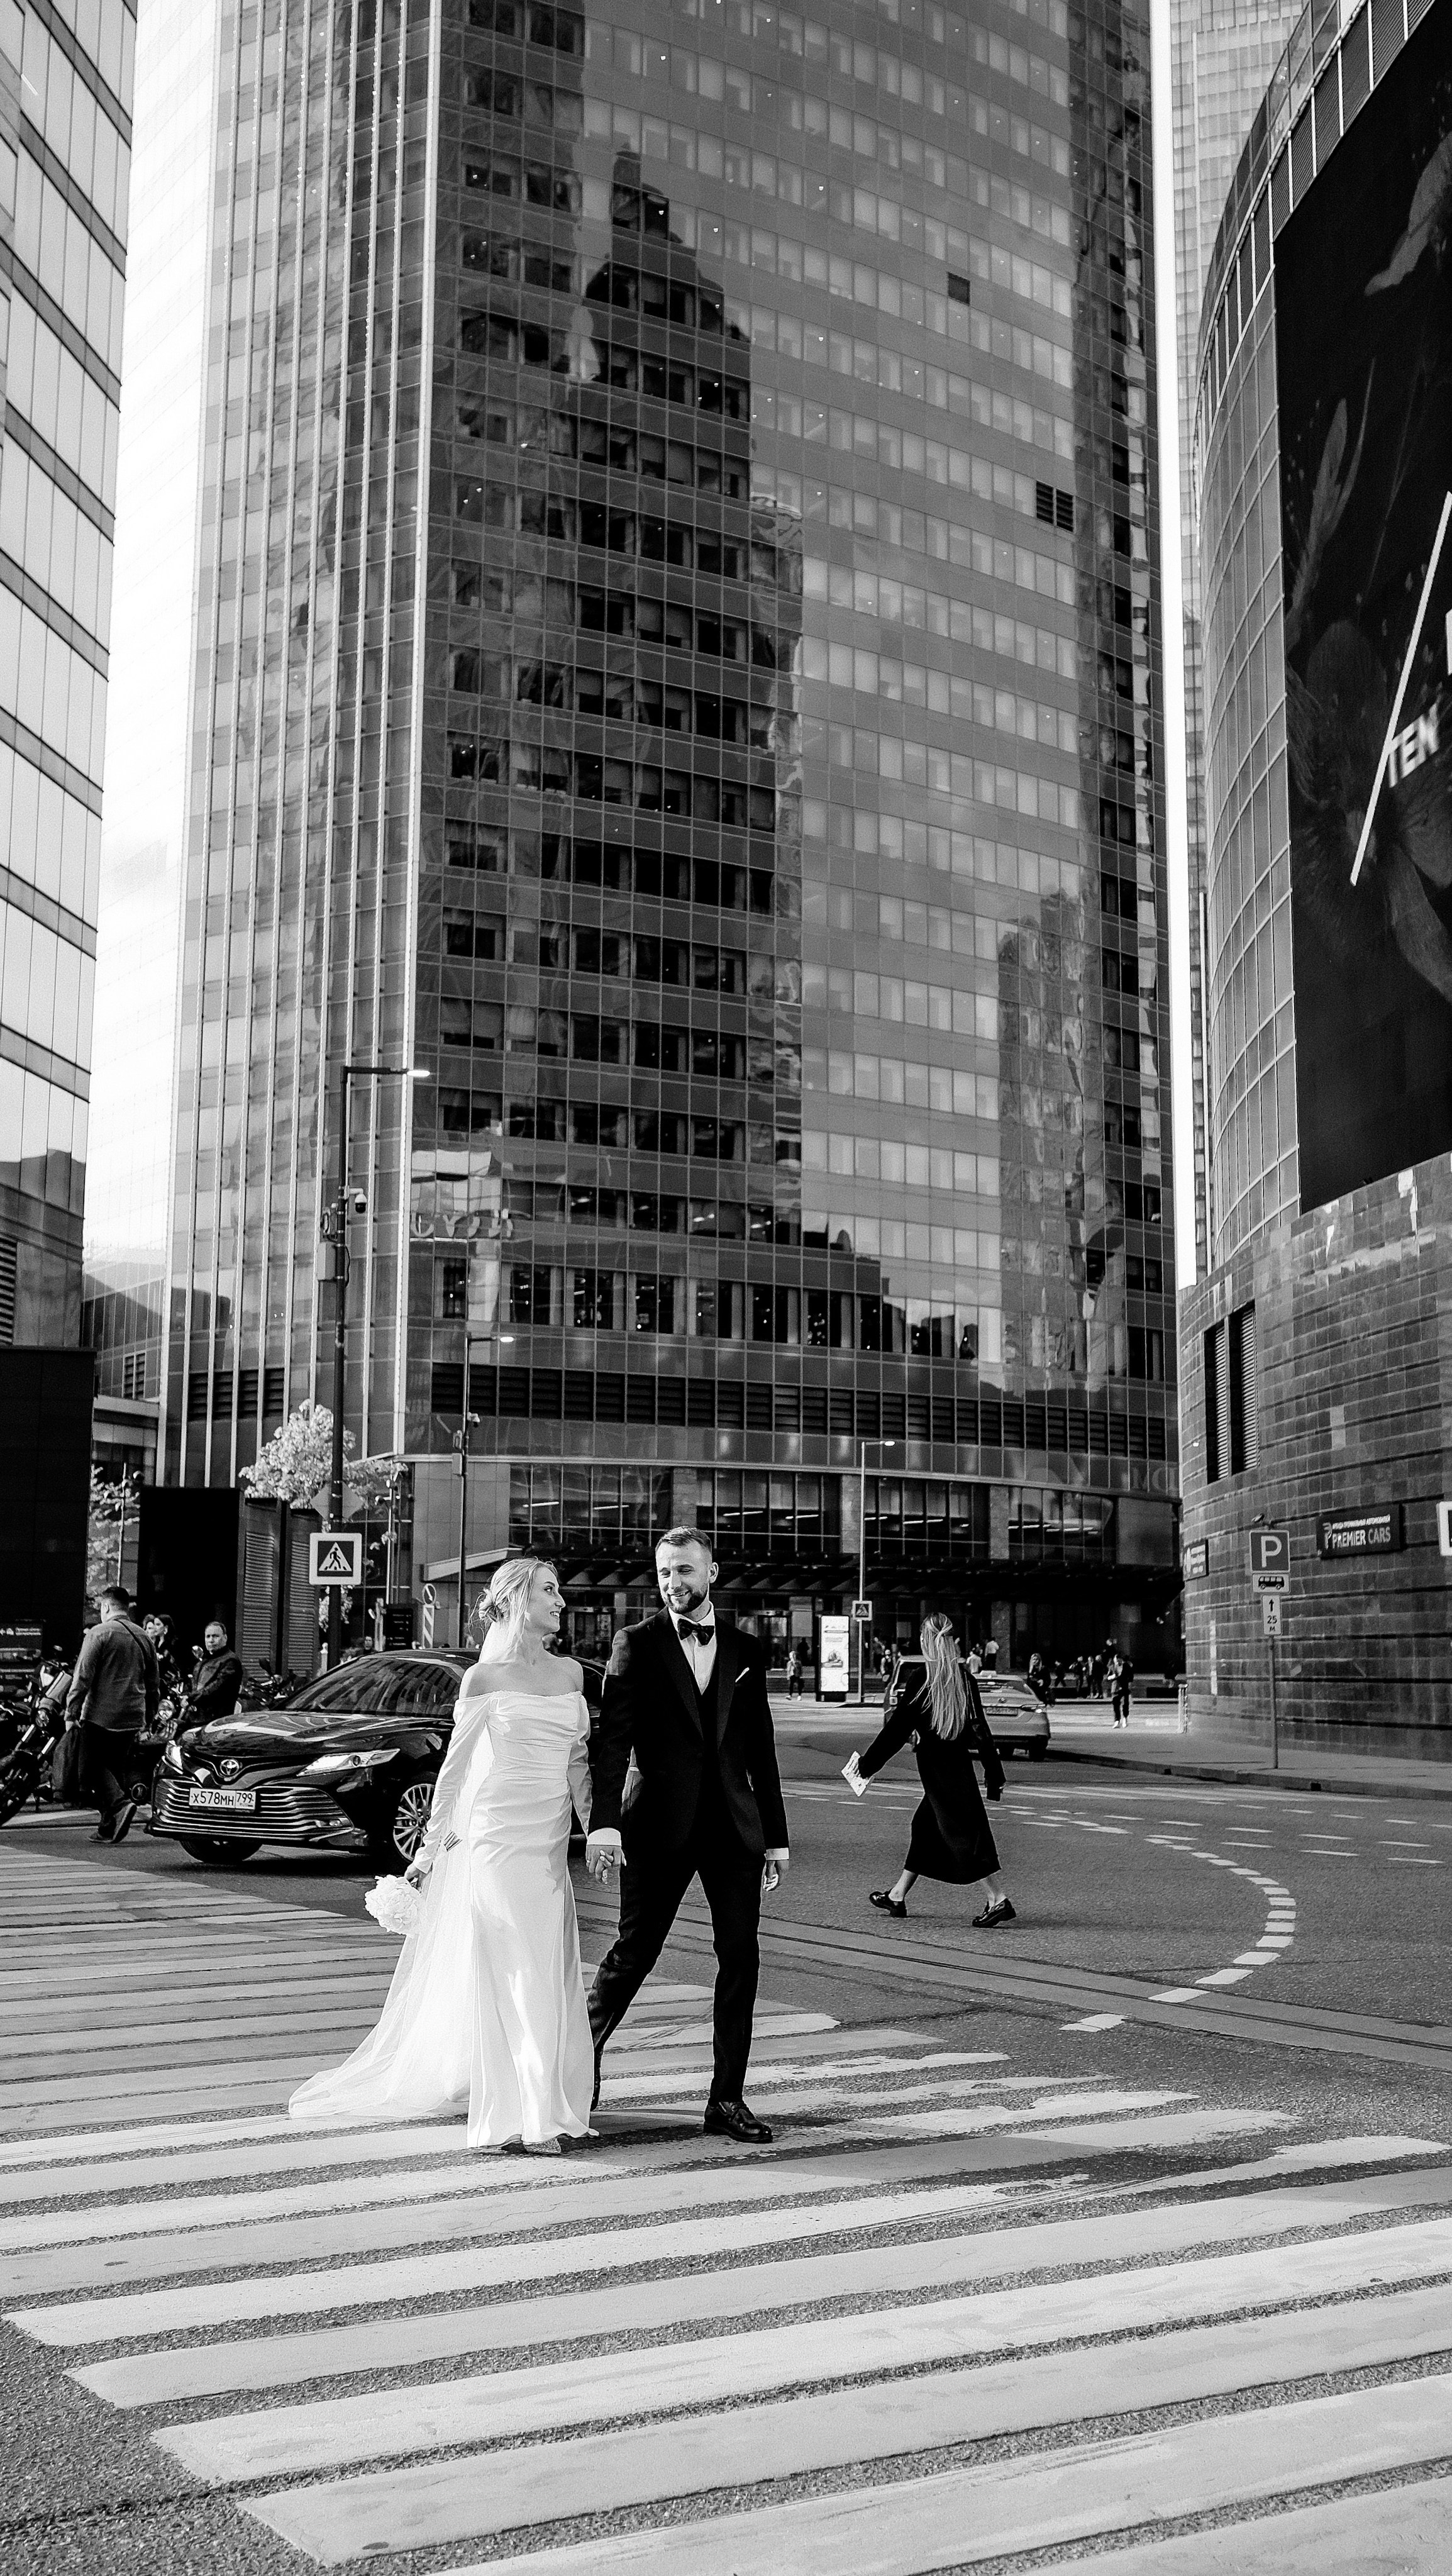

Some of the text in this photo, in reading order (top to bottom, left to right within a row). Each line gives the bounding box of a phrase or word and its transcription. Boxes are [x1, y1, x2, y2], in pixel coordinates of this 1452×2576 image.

[1332, 1526, 1391, 1548] PREMIER CARS
[1261, 1536, 1282, 1568] P
[1267, 1615, 1277, 1624] 25
[236, 1792, 253, 1803] 799
